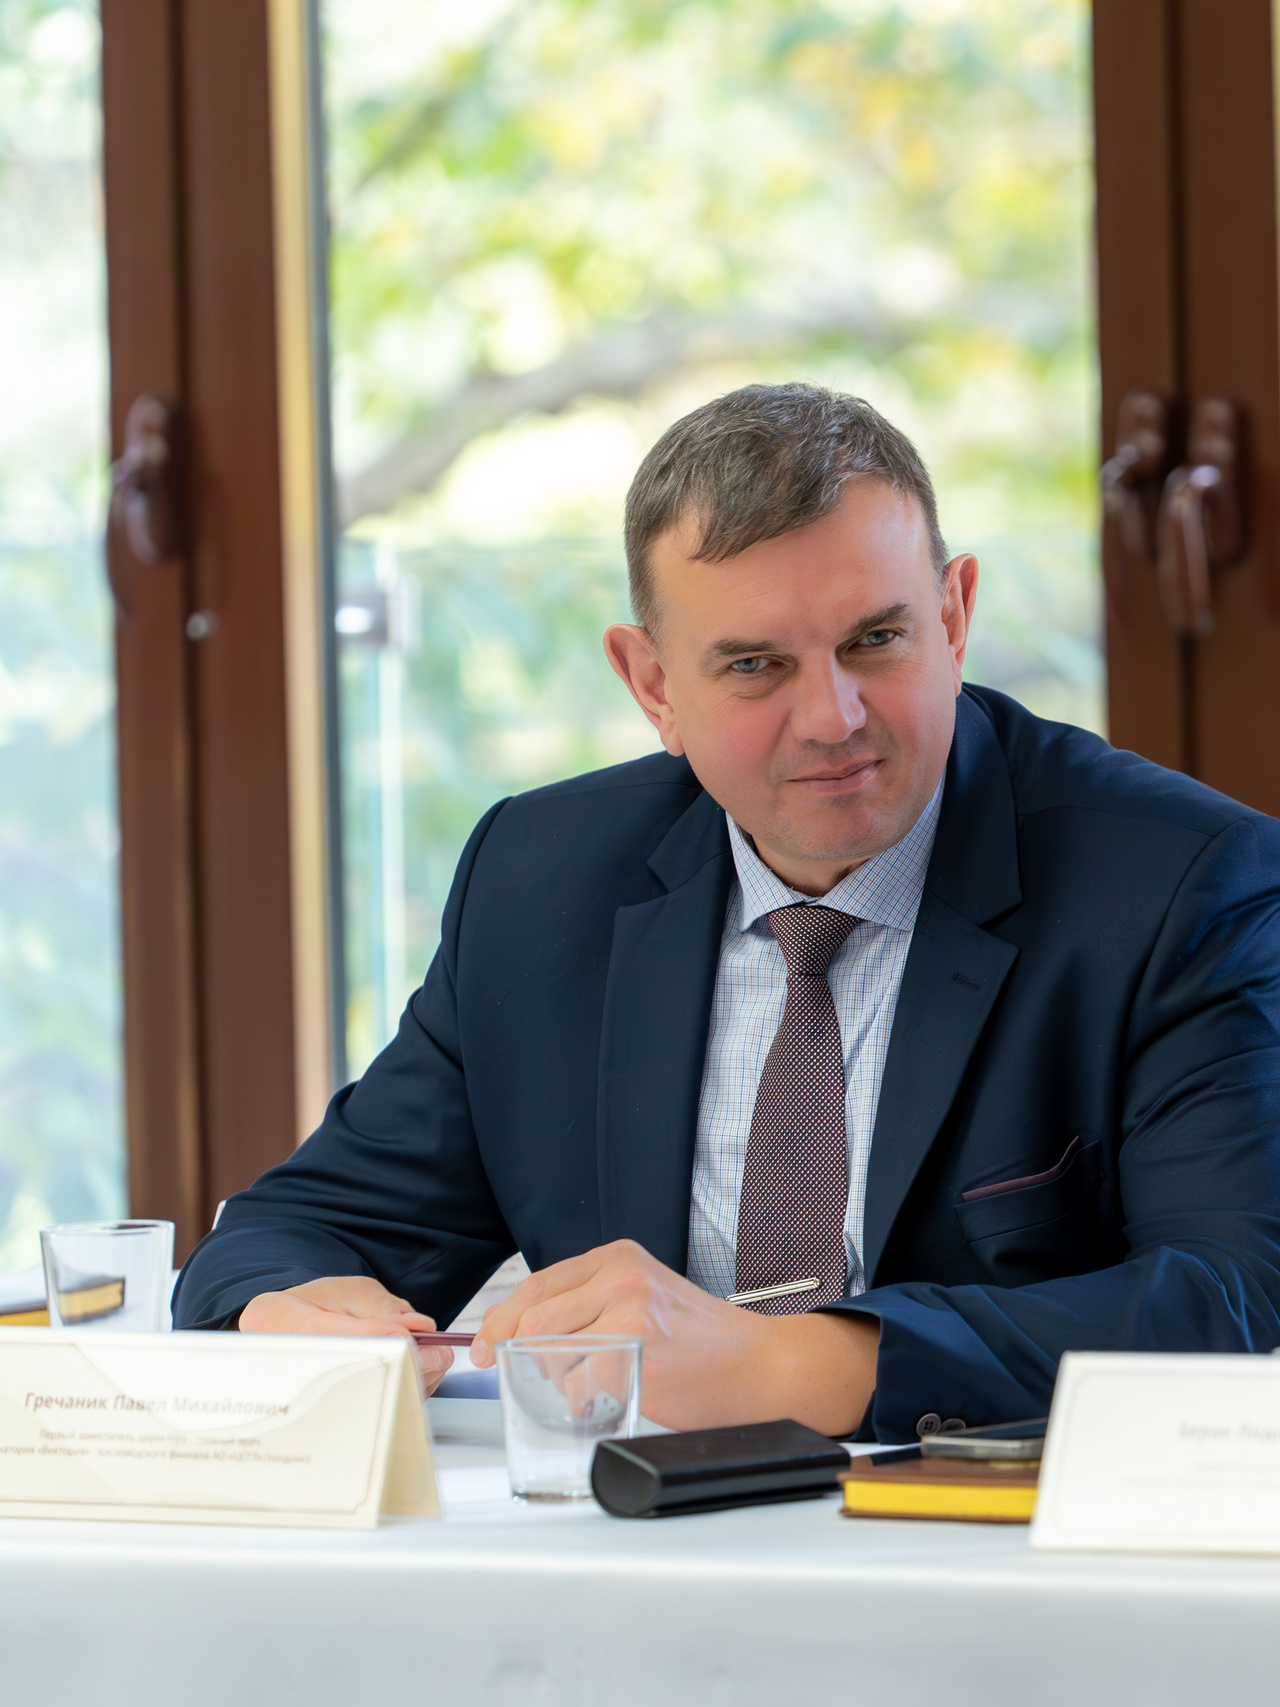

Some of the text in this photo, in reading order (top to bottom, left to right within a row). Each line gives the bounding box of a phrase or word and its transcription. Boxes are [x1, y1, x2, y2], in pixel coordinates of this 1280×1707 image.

[24, 1391, 290, 1415] Гречаник Павел Михайлович
